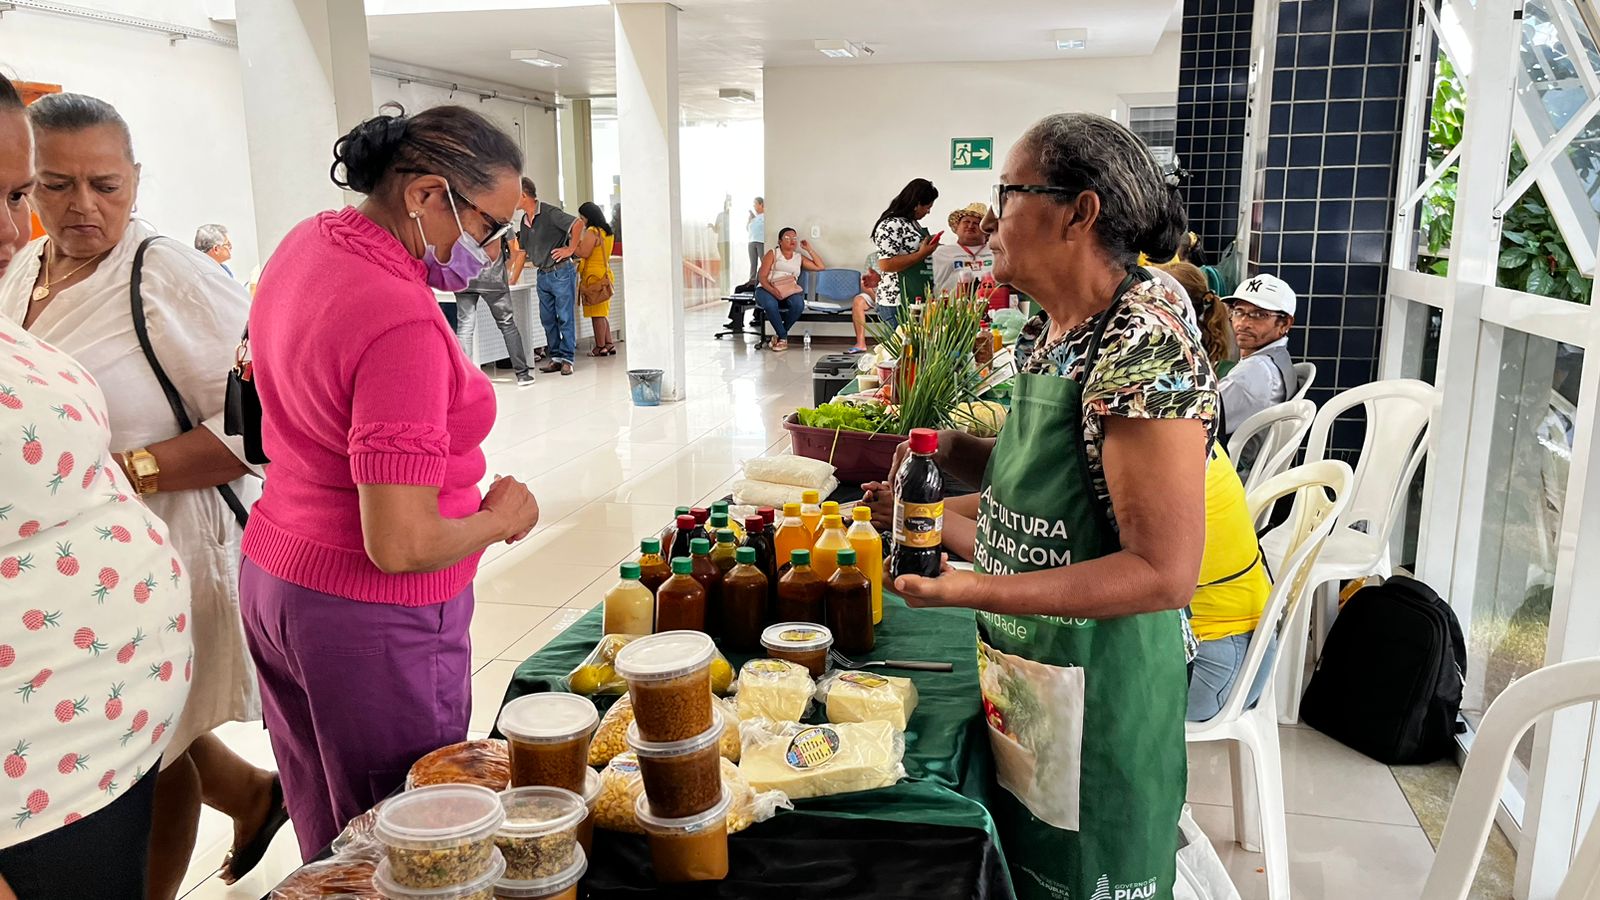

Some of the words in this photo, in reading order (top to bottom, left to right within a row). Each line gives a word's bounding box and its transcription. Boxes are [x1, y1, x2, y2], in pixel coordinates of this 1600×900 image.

[1018, 544, 1071, 567] COM
[976, 610, 1027, 640] alidade
[1114, 880, 1148, 889] GOVERNO
